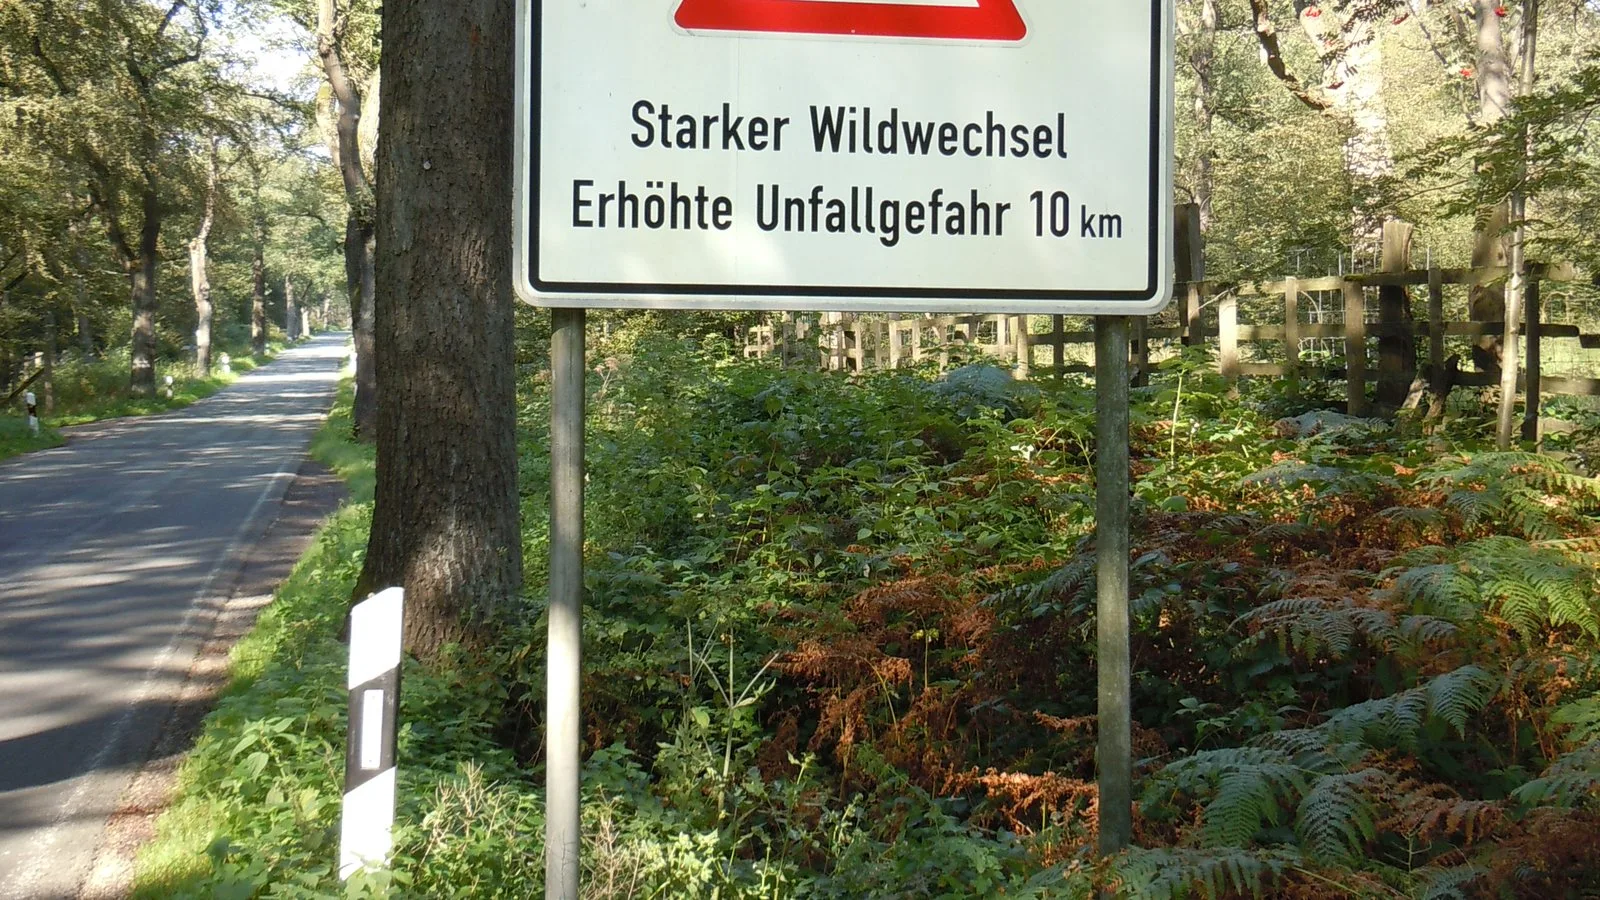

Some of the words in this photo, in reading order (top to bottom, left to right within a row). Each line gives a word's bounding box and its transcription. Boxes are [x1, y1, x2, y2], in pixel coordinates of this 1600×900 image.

[631, 99, 790, 151] Starker
[809, 105, 1068, 159] Wildwechsel
[572, 179, 733, 231] Erhöhte
[756, 183, 1011, 248] Unfallgefahr
[1030, 190, 1070, 238] 10
[1081, 204, 1122, 238] km
